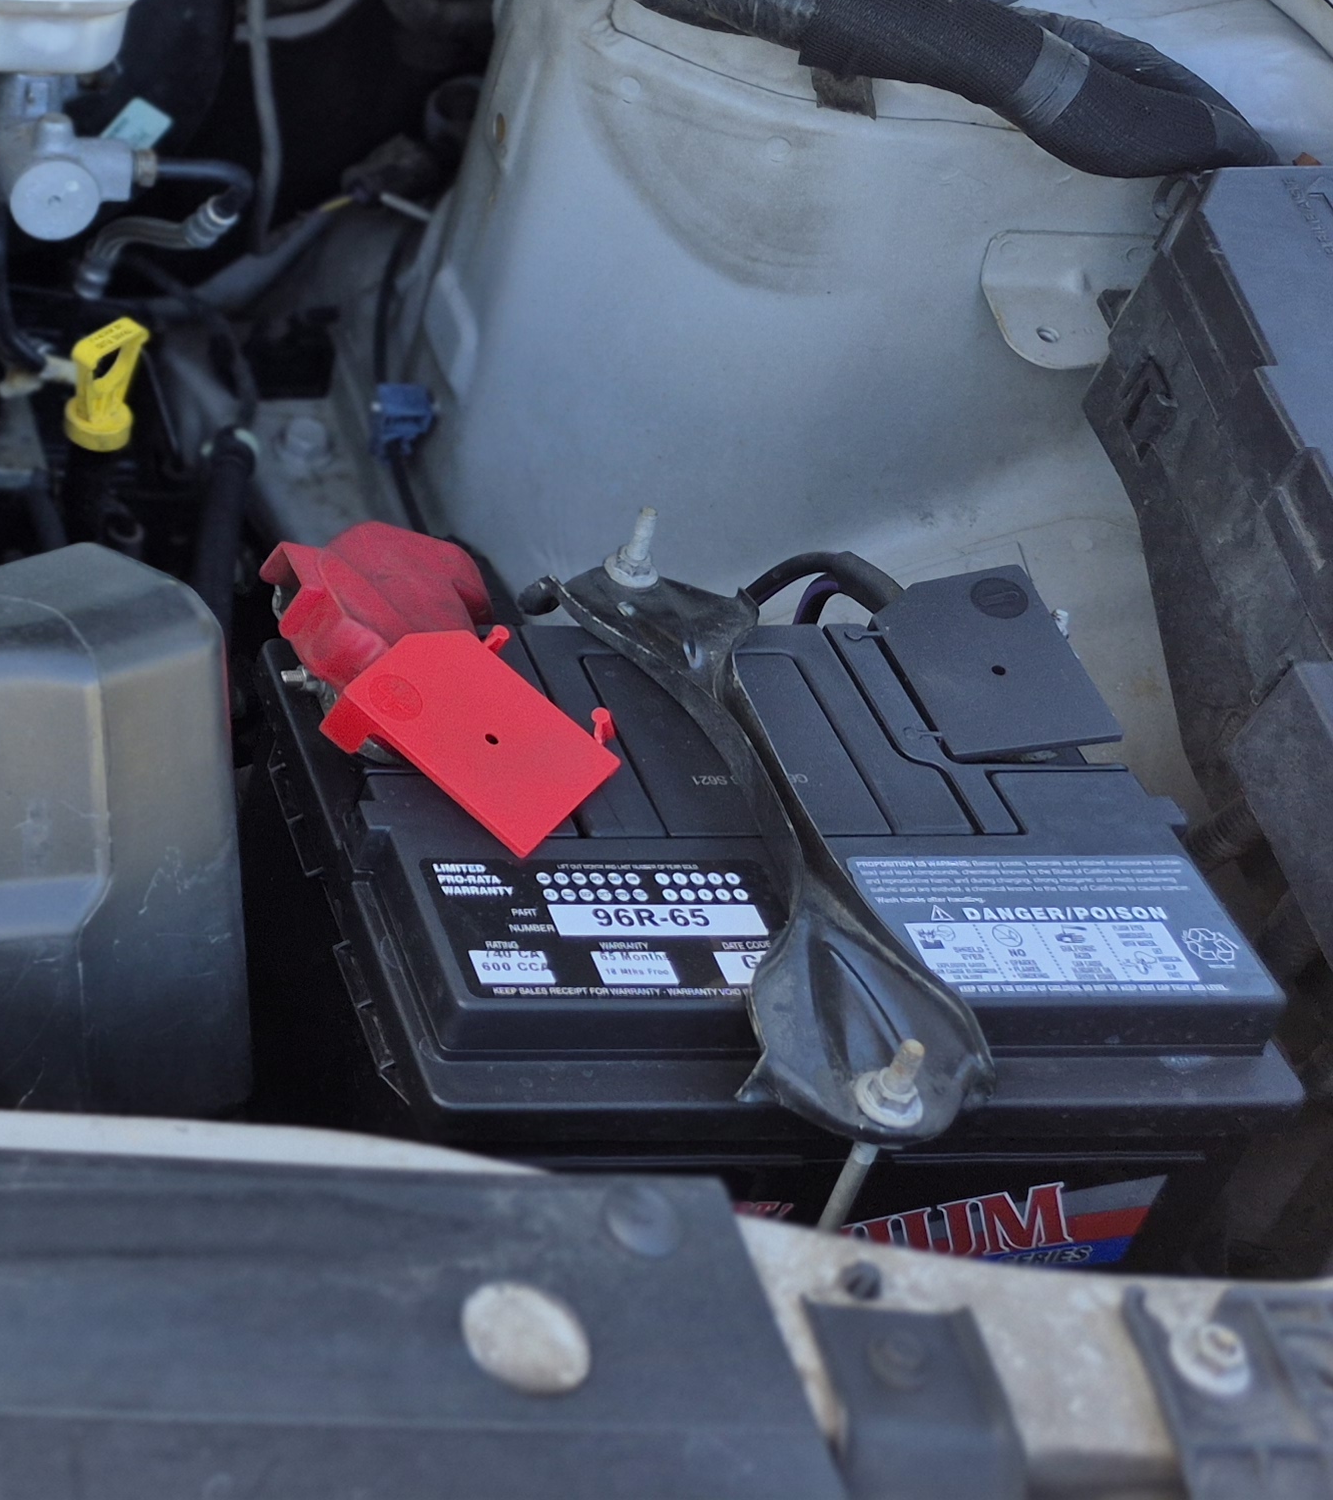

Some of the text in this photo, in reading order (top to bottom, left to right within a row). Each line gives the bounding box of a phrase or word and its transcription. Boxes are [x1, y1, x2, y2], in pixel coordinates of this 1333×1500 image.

[691, 775, 728, 786] S621
[433, 863, 486, 873] LIMITED
[437, 875, 502, 885] PRO-RATA
[441, 886, 513, 896] WARRANTY
[511, 908, 538, 916] PART
[962, 906, 1168, 921] DANGER/POISON
[592, 908, 710, 928] 96R-65
[509, 924, 555, 932] NUMBER
[485, 941, 519, 949] RATING
[599, 942, 649, 950] WARRANTY
[722, 940, 771, 950] DATE CODE
[518, 951, 541, 959] CA
[600, 952, 617, 961] 65
[1007, 949, 1027, 957] NO
[481, 962, 549, 971] 600 CCA
[493, 987, 517, 995] KEEP
[519, 987, 547, 995] SALES
[549, 987, 587, 995] RECEIPT
[589, 987, 609, 995] FOR
[610, 987, 660, 995] WARRANTY
[667, 987, 717, 995] WARRANTY
[718, 987, 740, 995] VOID
